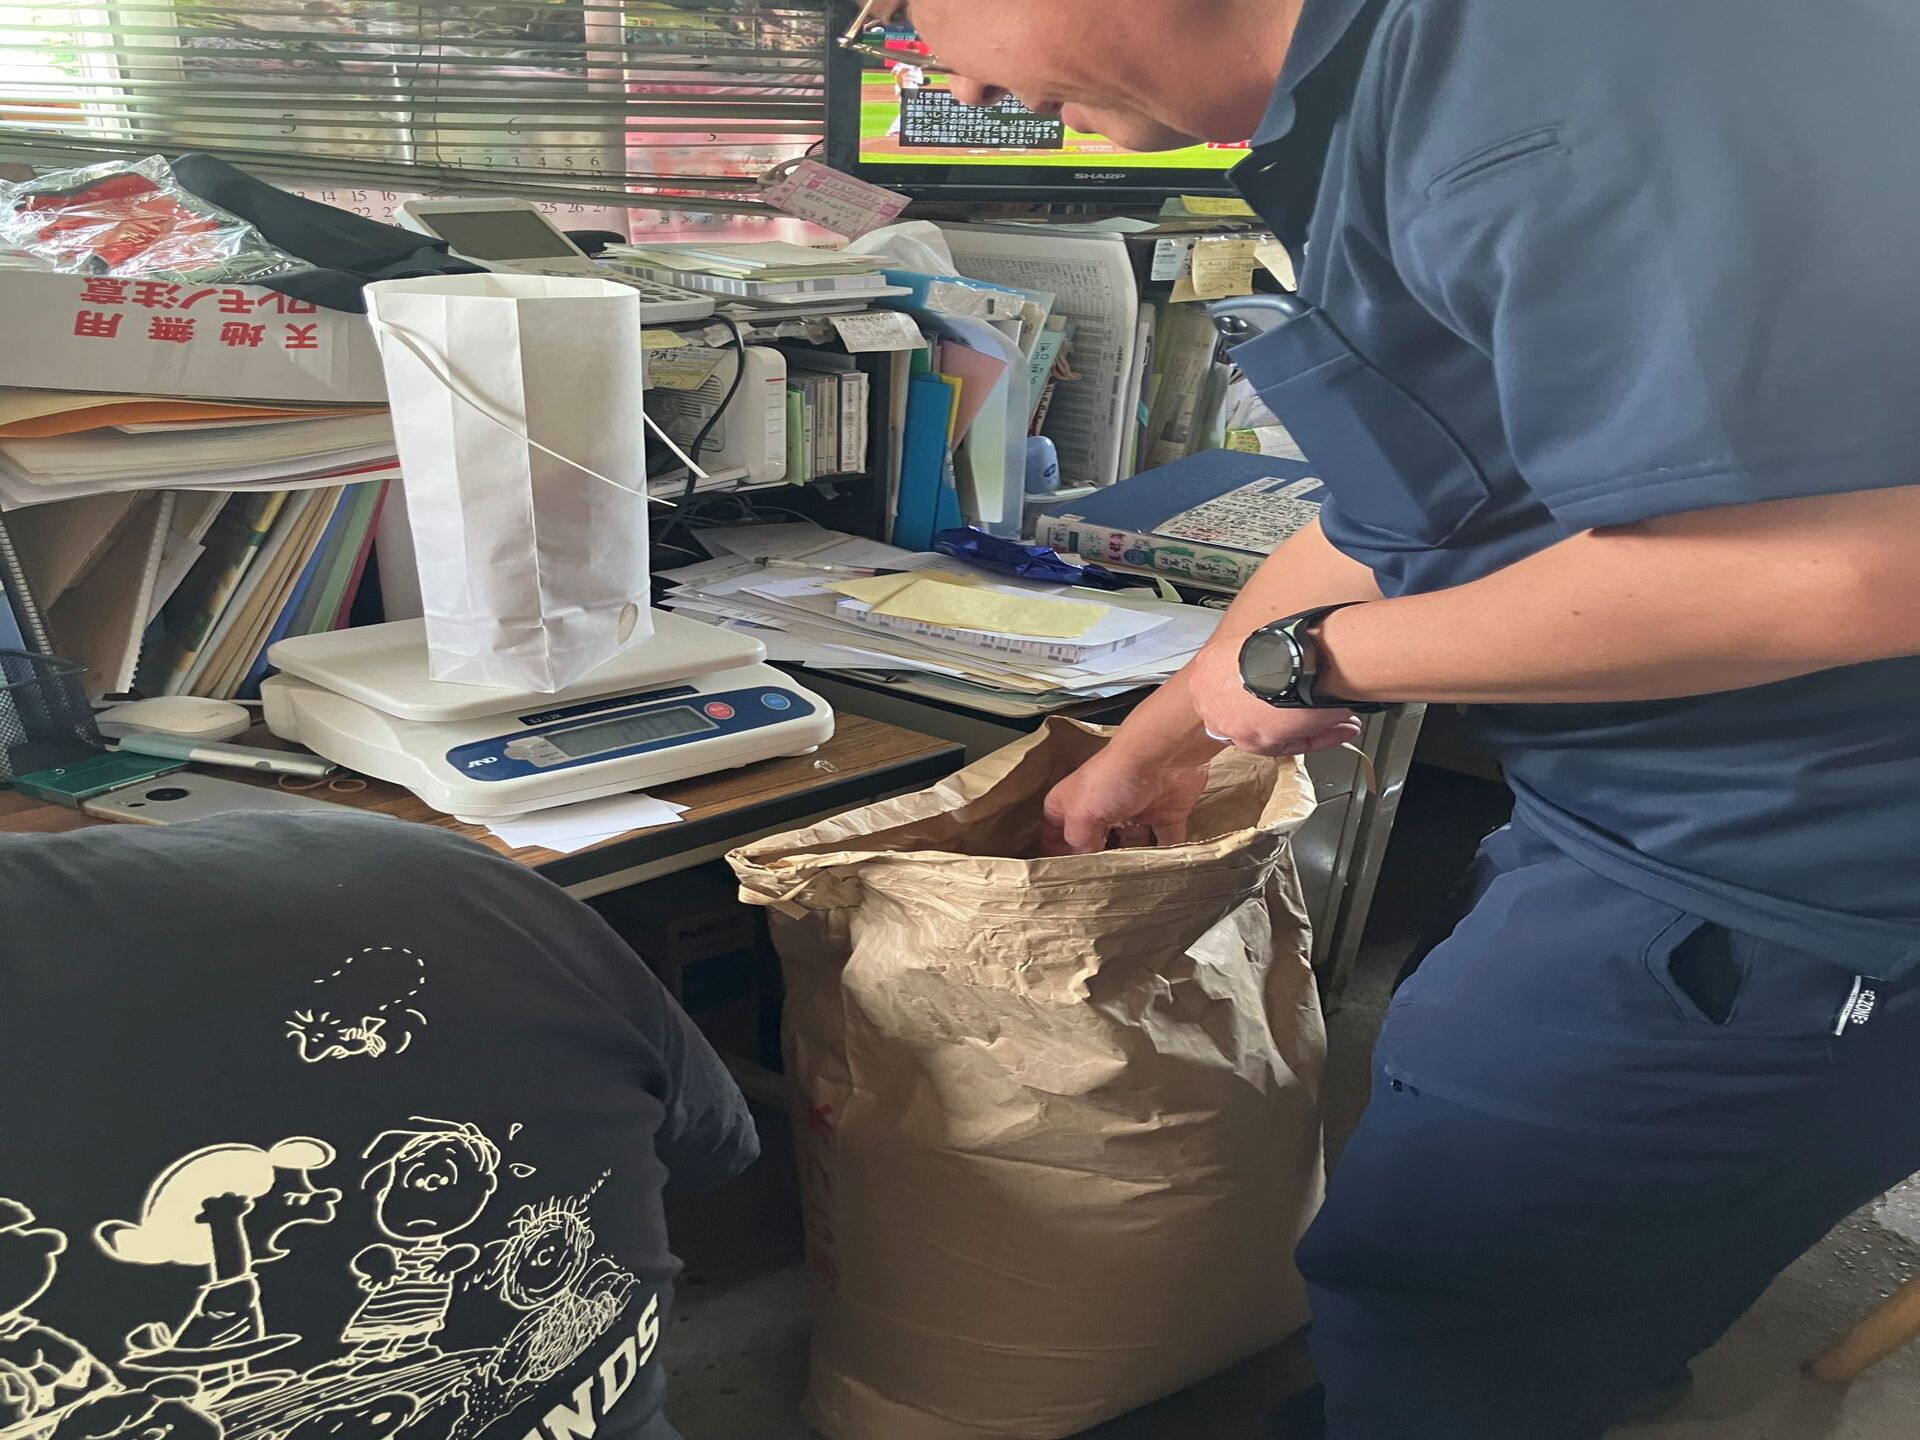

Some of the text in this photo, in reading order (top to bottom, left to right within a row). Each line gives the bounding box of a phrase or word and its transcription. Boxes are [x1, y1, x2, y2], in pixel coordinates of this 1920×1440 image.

[564, 156, 573, 167] 5
[590, 156, 600, 167] 6
[1073, 172, 1126, 180] SHARP
[321, 190, 397, 202] 14 15 16
[540, 203, 557, 214] 25
[568, 203, 584, 213] 26
[73, 309, 318, 349] 天地無用
[522, 1292, 660, 1440] NDS
